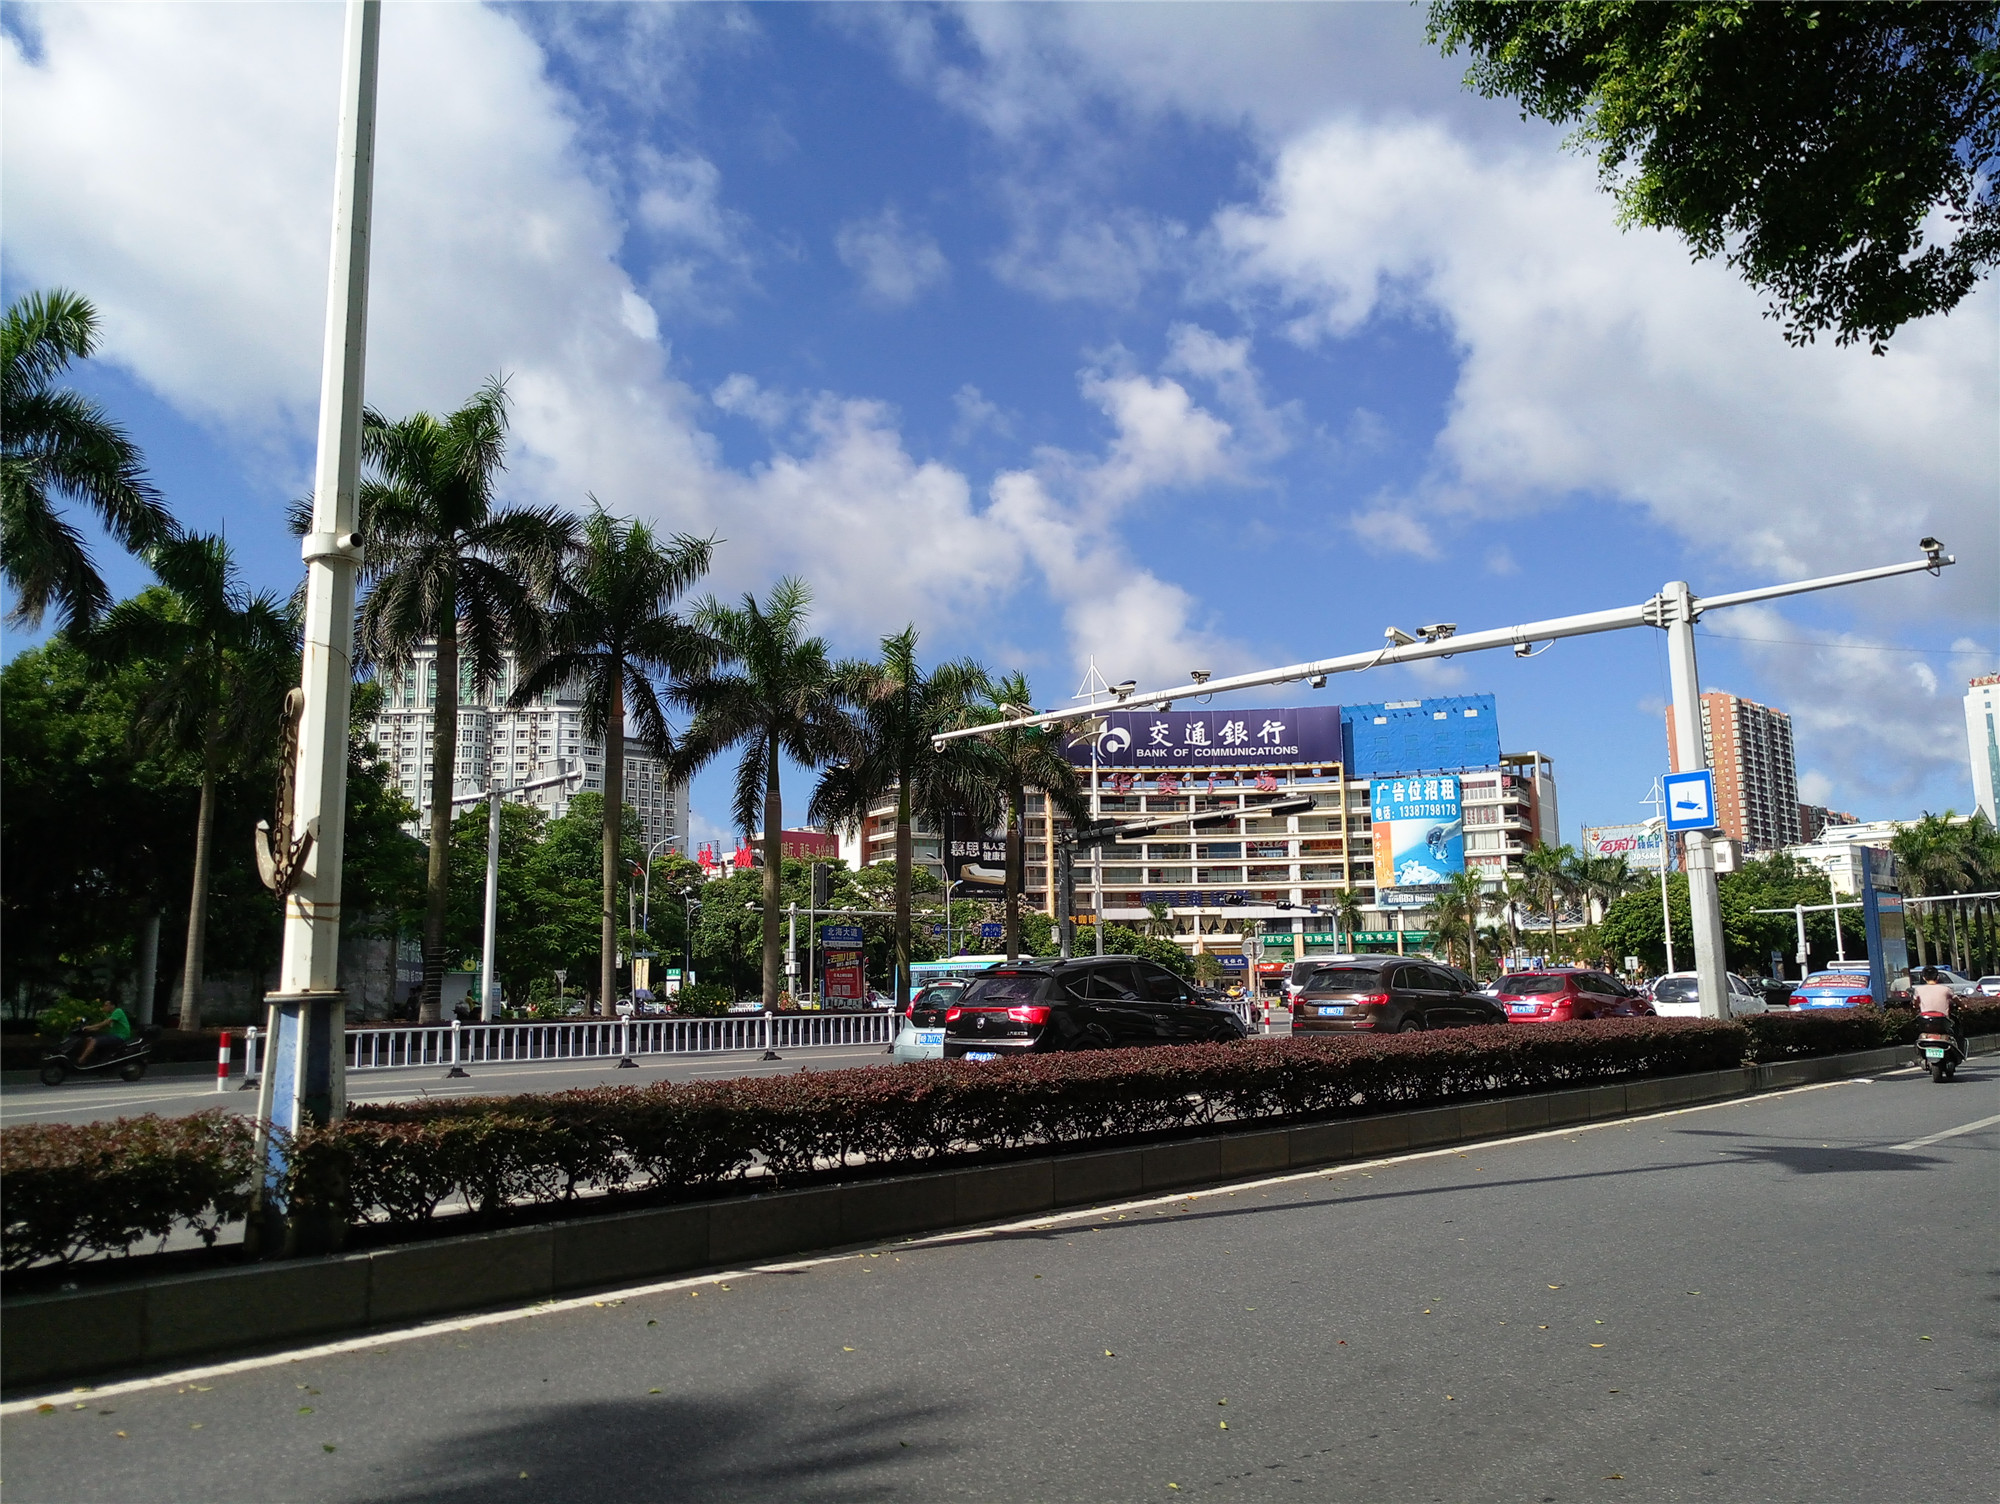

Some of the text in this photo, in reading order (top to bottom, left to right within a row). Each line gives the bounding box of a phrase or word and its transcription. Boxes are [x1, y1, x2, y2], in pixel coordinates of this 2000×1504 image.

[1149, 719, 1286, 747] 交通銀行
[1136, 745, 1299, 758] BANK OF COMMUNICATIONS
[1375, 778, 1456, 805] 广告位招租
